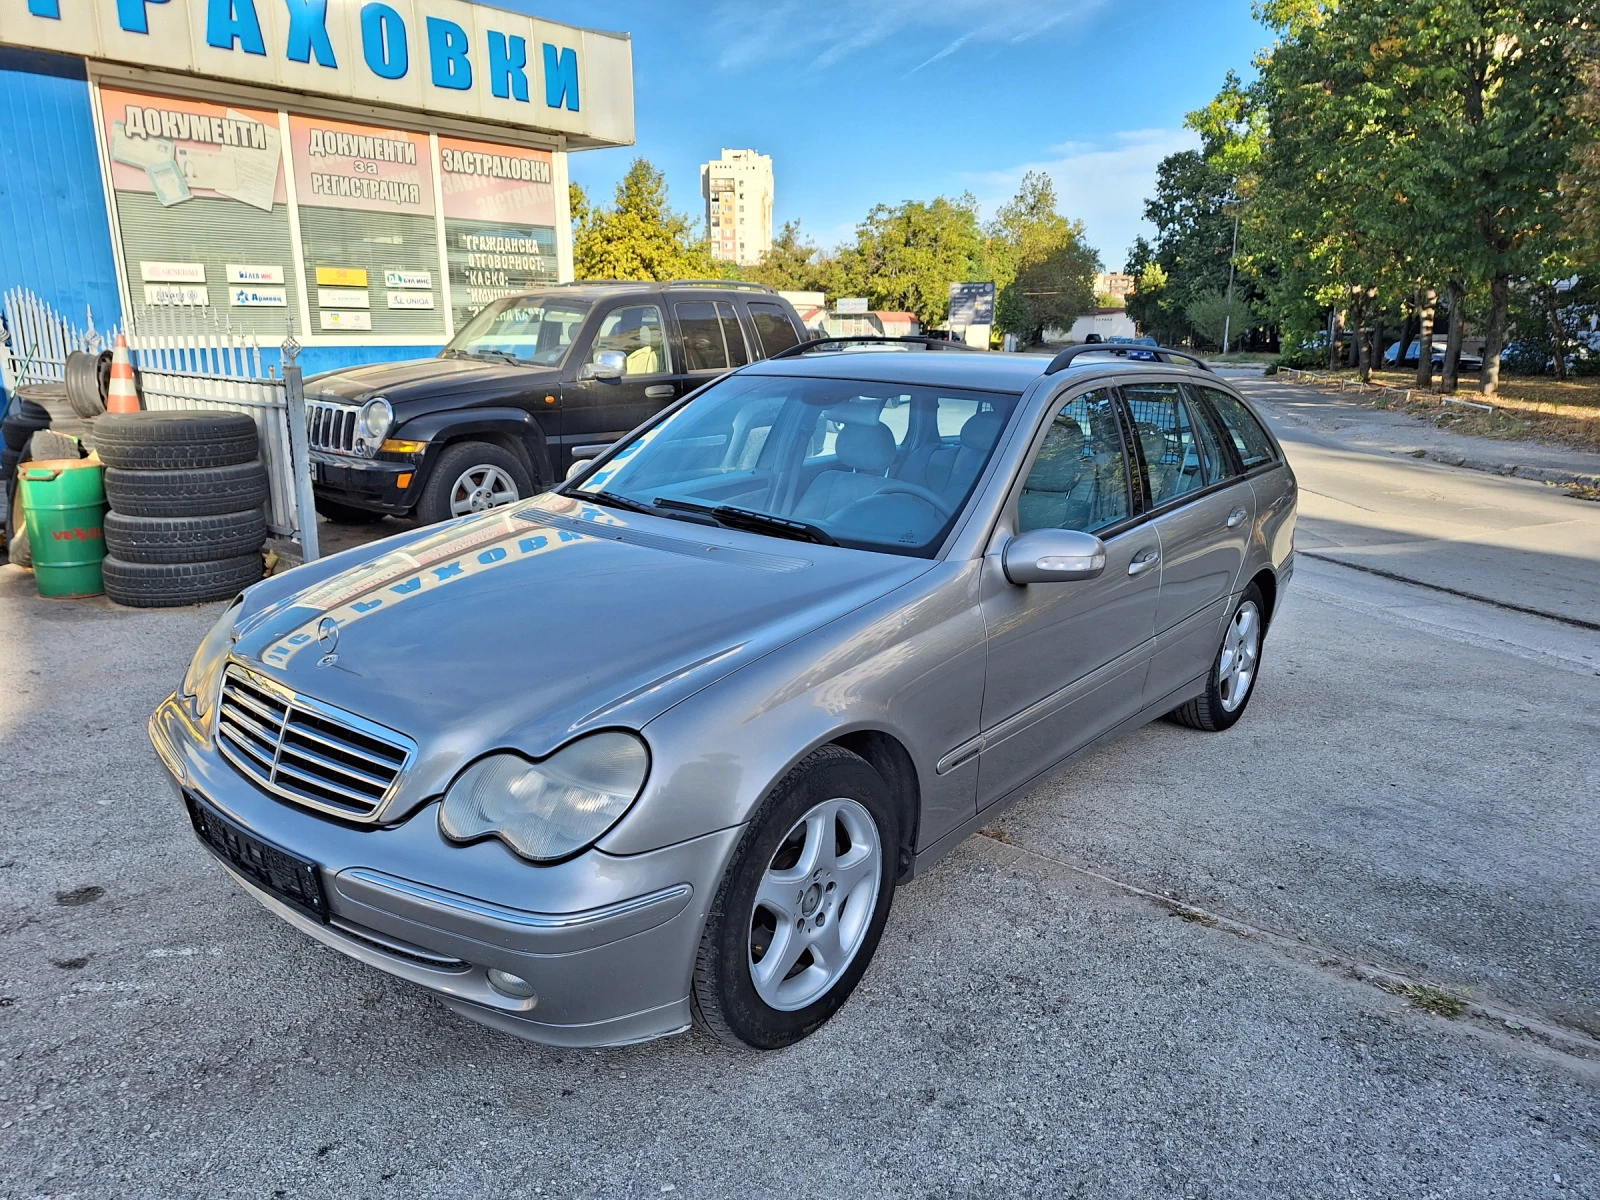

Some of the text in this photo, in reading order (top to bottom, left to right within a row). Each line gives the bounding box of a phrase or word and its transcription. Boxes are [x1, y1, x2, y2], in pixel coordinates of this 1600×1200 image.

[28, 0, 580, 112] АХОВКИ
[124, 105, 267, 150] ДОКУМЕНТИ
[309, 128, 417, 165] ДОКУМЕНТИ
[353, 160, 378, 175] за
[441, 148, 551, 184] ЗАСТРАХОВКИ
[311, 172, 420, 205] РЕГИСТРАЦИЯ
[465, 235, 540, 254] ГРАЖДАНСКА
[406, 297, 430, 305] UNIQA
